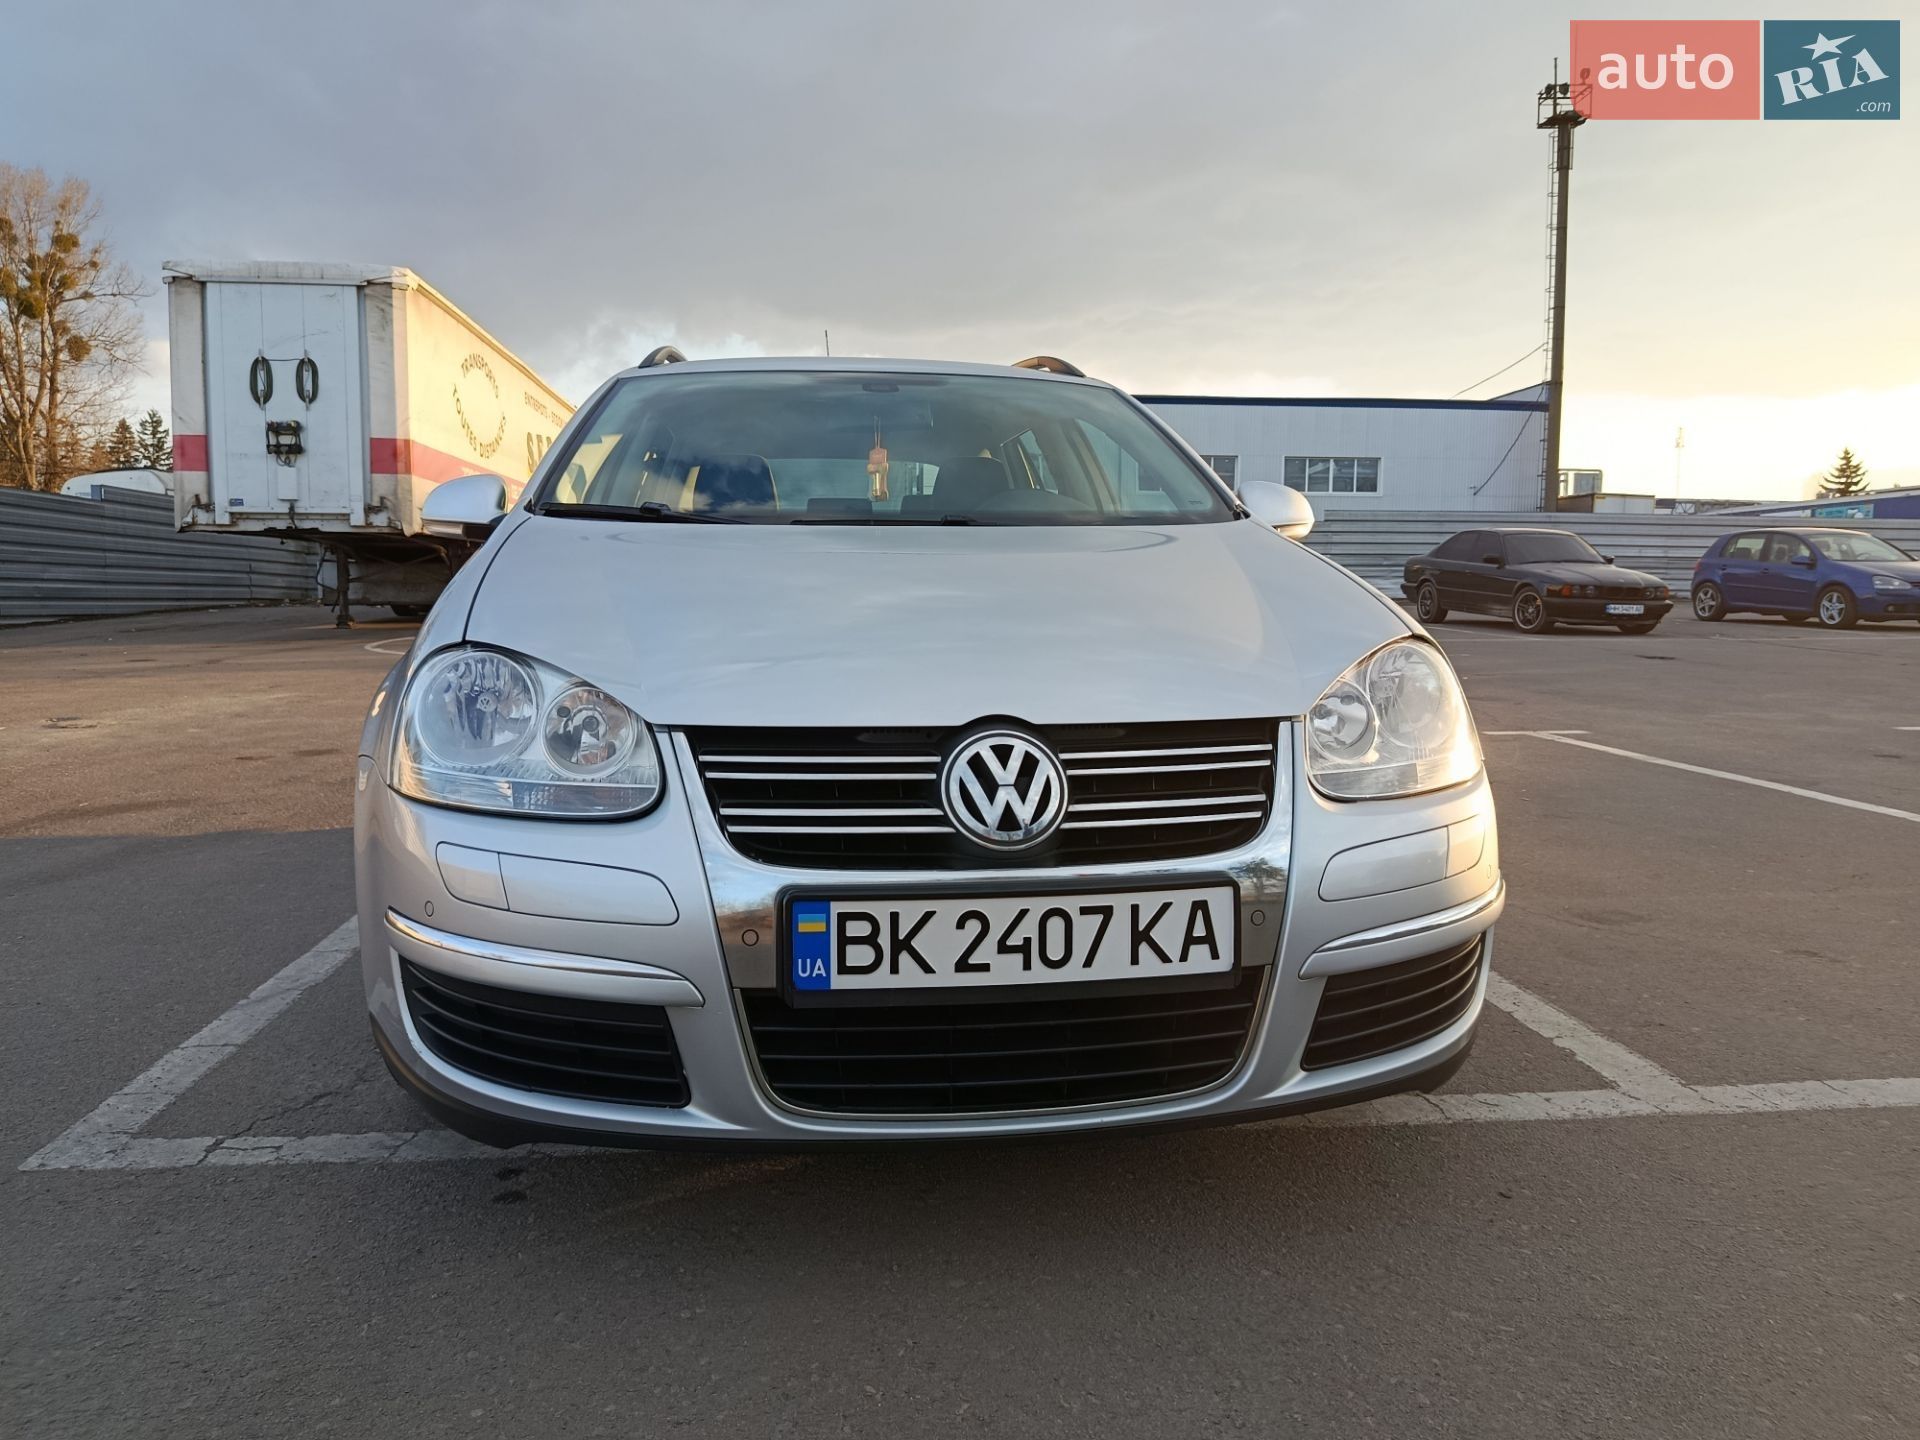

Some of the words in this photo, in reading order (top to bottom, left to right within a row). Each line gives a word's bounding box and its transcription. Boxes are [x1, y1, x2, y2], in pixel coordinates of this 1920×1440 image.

[461, 353, 499, 399] TRANSPORTS
[452, 383, 477, 452] TOUTES
[836, 910, 937, 975] BK
[954, 905, 1114, 973] 2407
[1130, 899, 1220, 966] KA
[798, 958, 826, 977] UA
